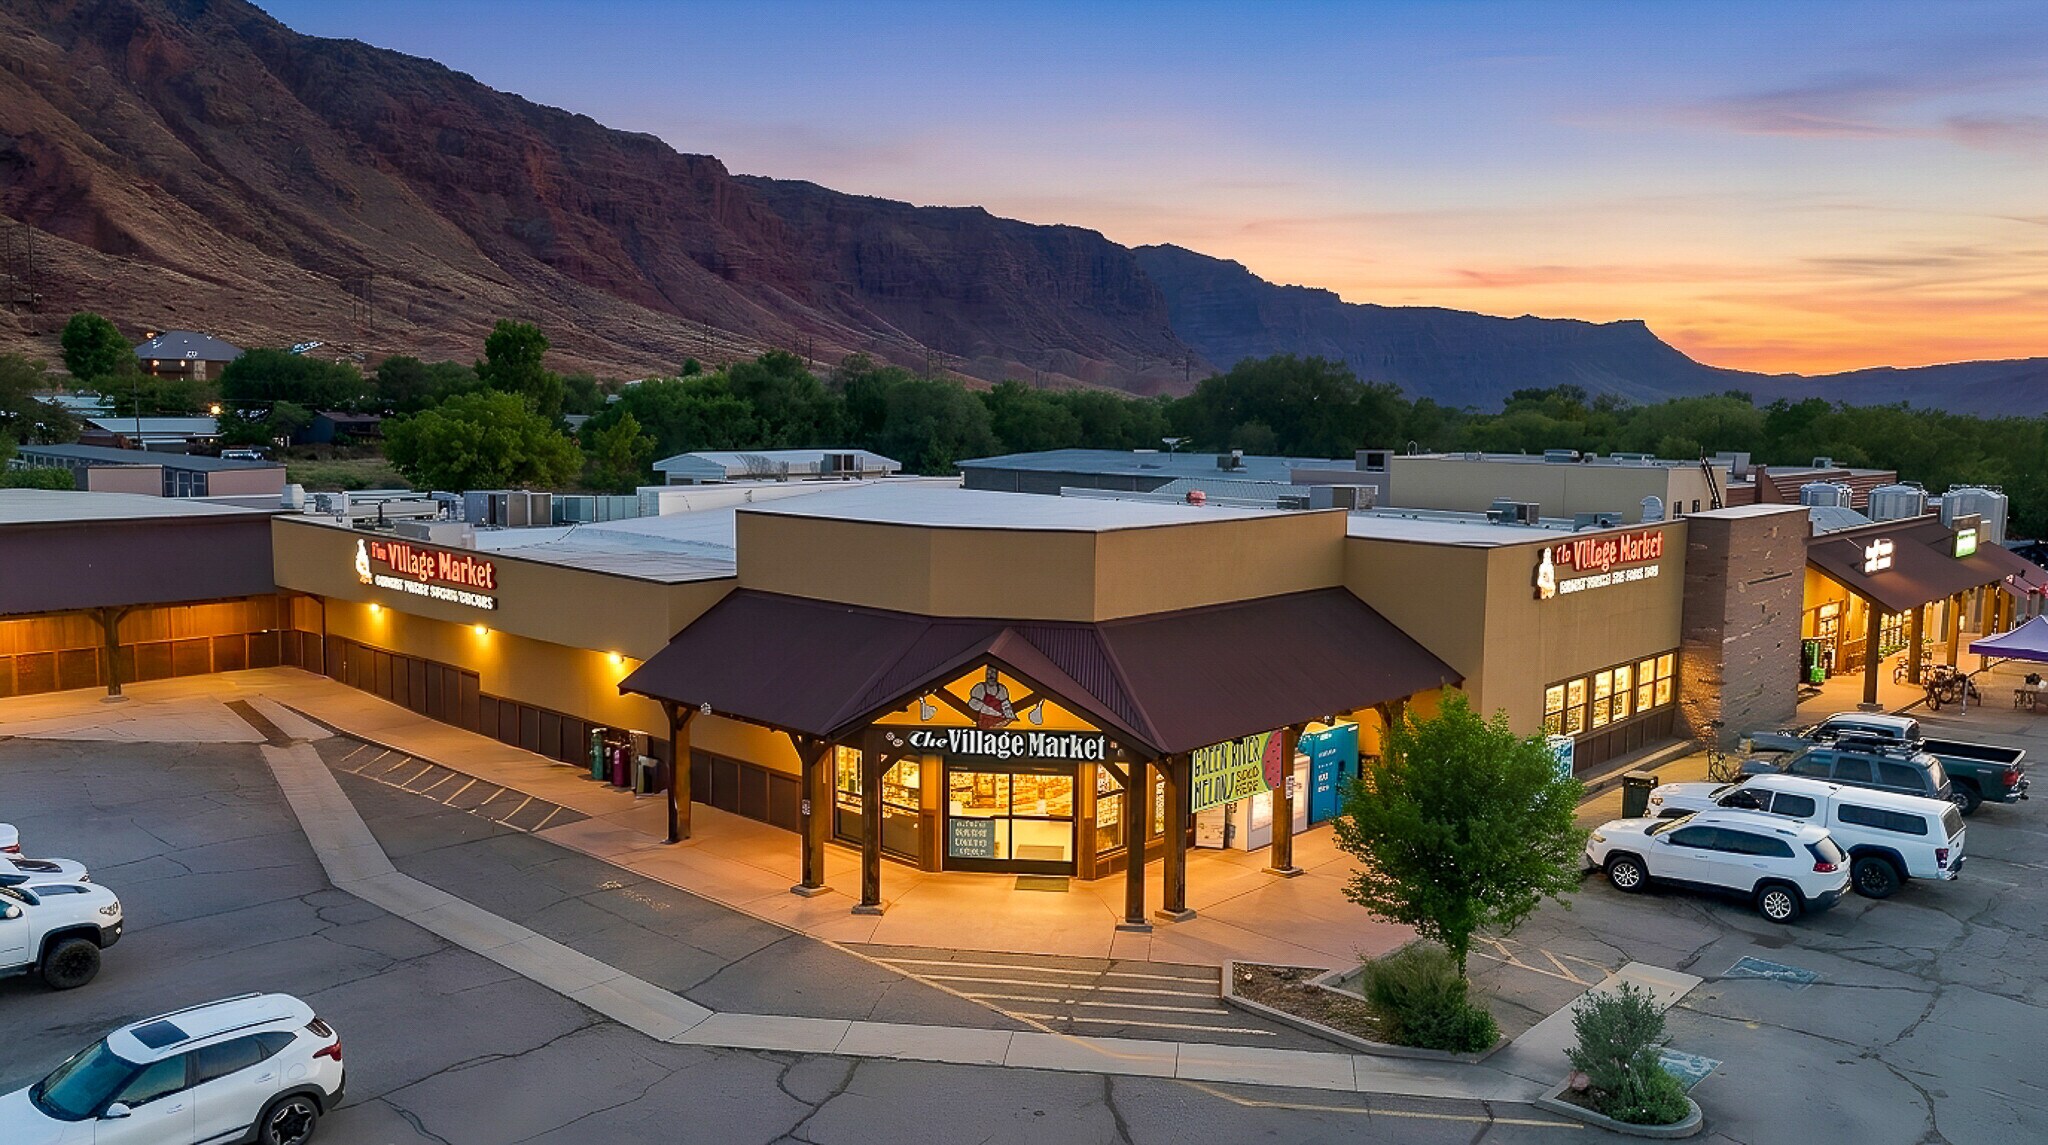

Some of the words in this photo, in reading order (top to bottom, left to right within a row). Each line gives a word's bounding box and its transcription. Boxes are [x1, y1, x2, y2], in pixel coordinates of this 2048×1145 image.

[1620, 531, 1663, 562] Market
[438, 551, 493, 589] Market
[908, 731, 947, 748] The
[947, 728, 1025, 759] Village
[1028, 732, 1105, 760] Market
